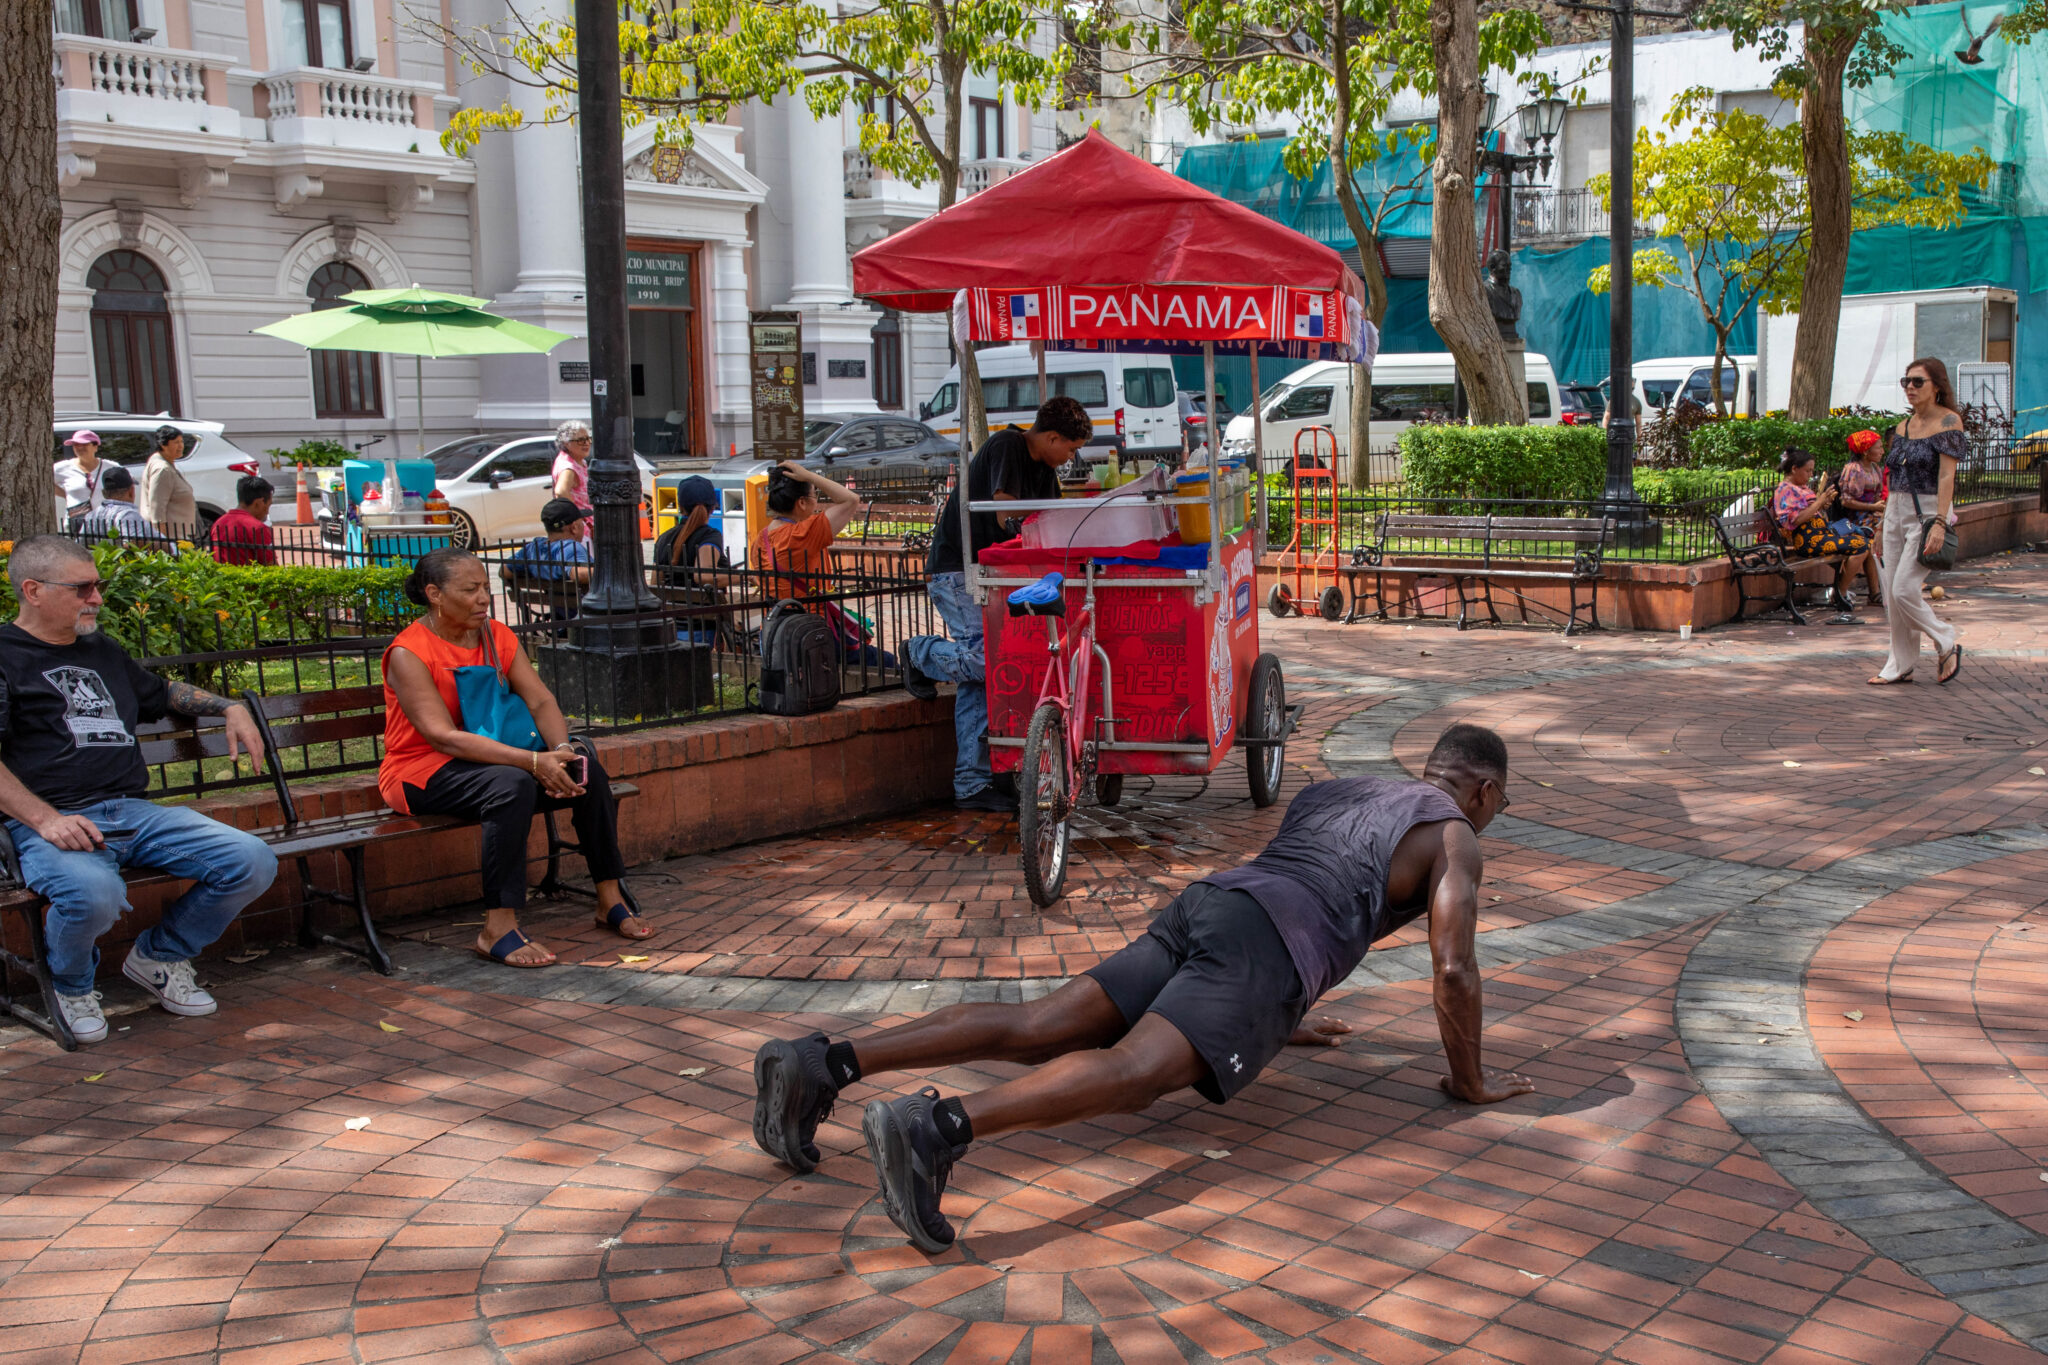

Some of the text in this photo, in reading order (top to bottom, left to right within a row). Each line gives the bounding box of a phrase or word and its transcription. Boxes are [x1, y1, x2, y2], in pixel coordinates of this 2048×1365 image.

[645, 259, 686, 271] MUNICIPAL
[638, 291, 660, 300] 1910
[1070, 293, 1265, 329] PANAMA
[997, 295, 1007, 339] PANAMA
[1327, 291, 1337, 338] PANAMA
[1100, 604, 1172, 631] EVENTOS
